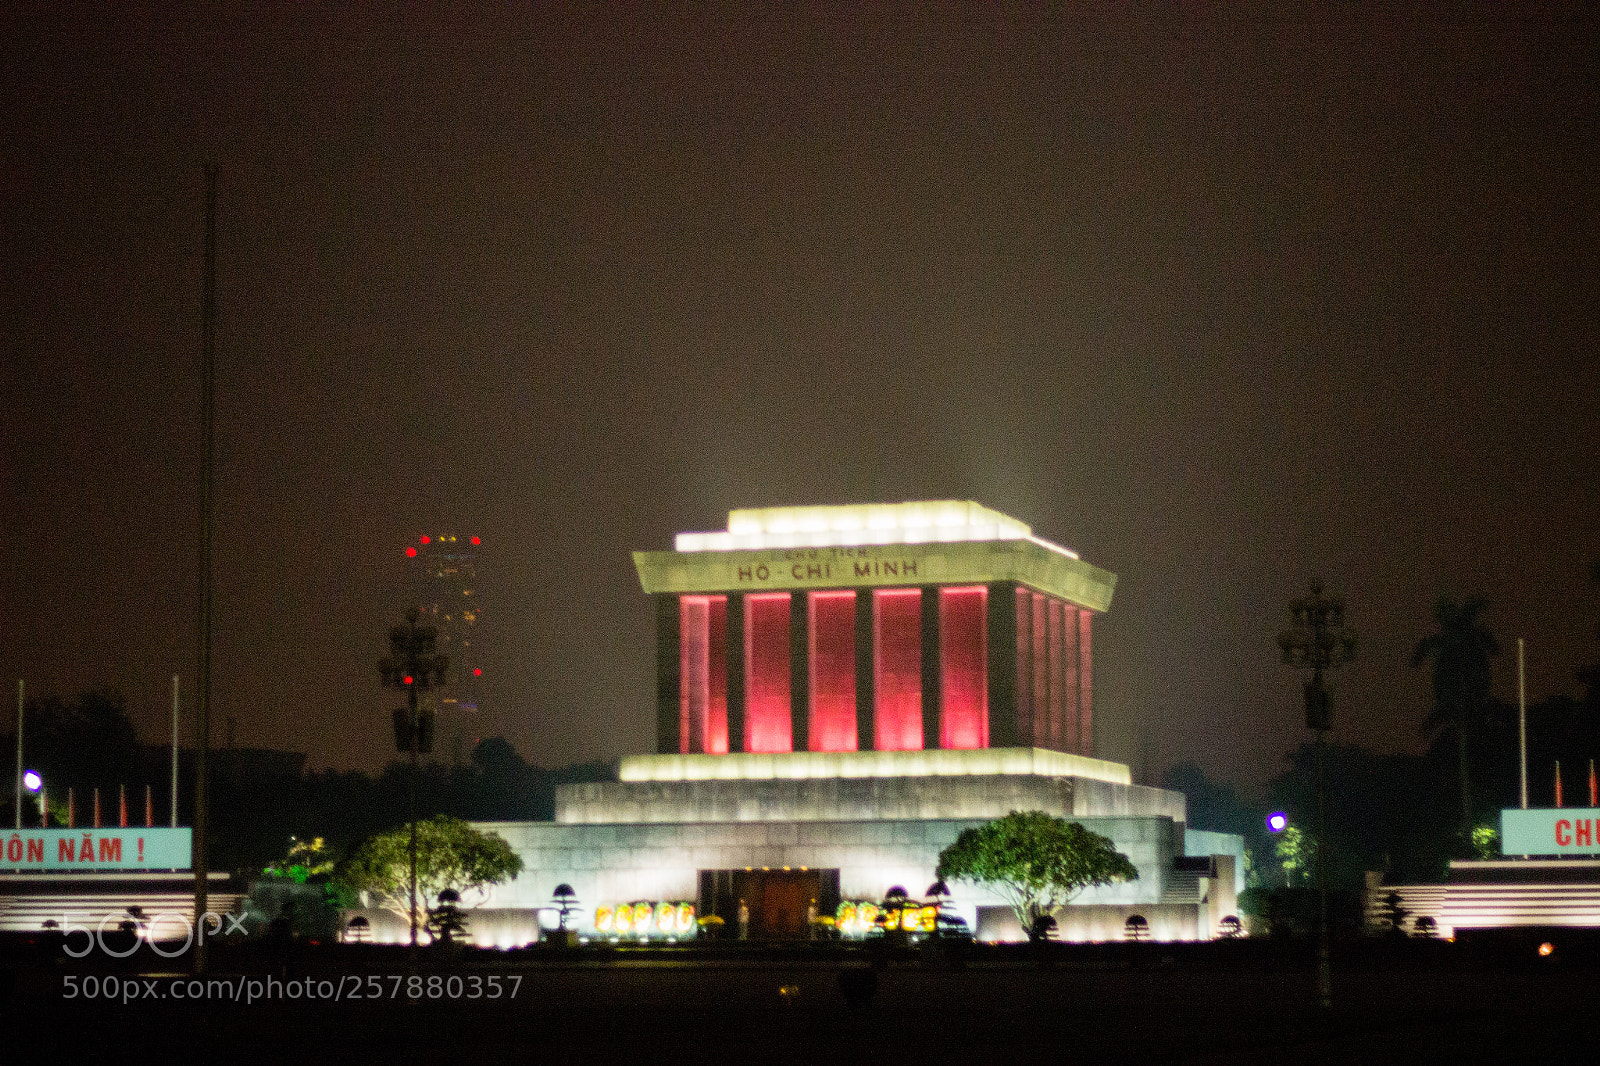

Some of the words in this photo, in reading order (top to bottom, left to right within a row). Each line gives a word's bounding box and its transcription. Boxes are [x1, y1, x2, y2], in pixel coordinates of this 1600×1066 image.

[853, 558, 918, 578] MINH
[0, 833, 44, 863] ÔN
[58, 832, 122, 862] NĂM
